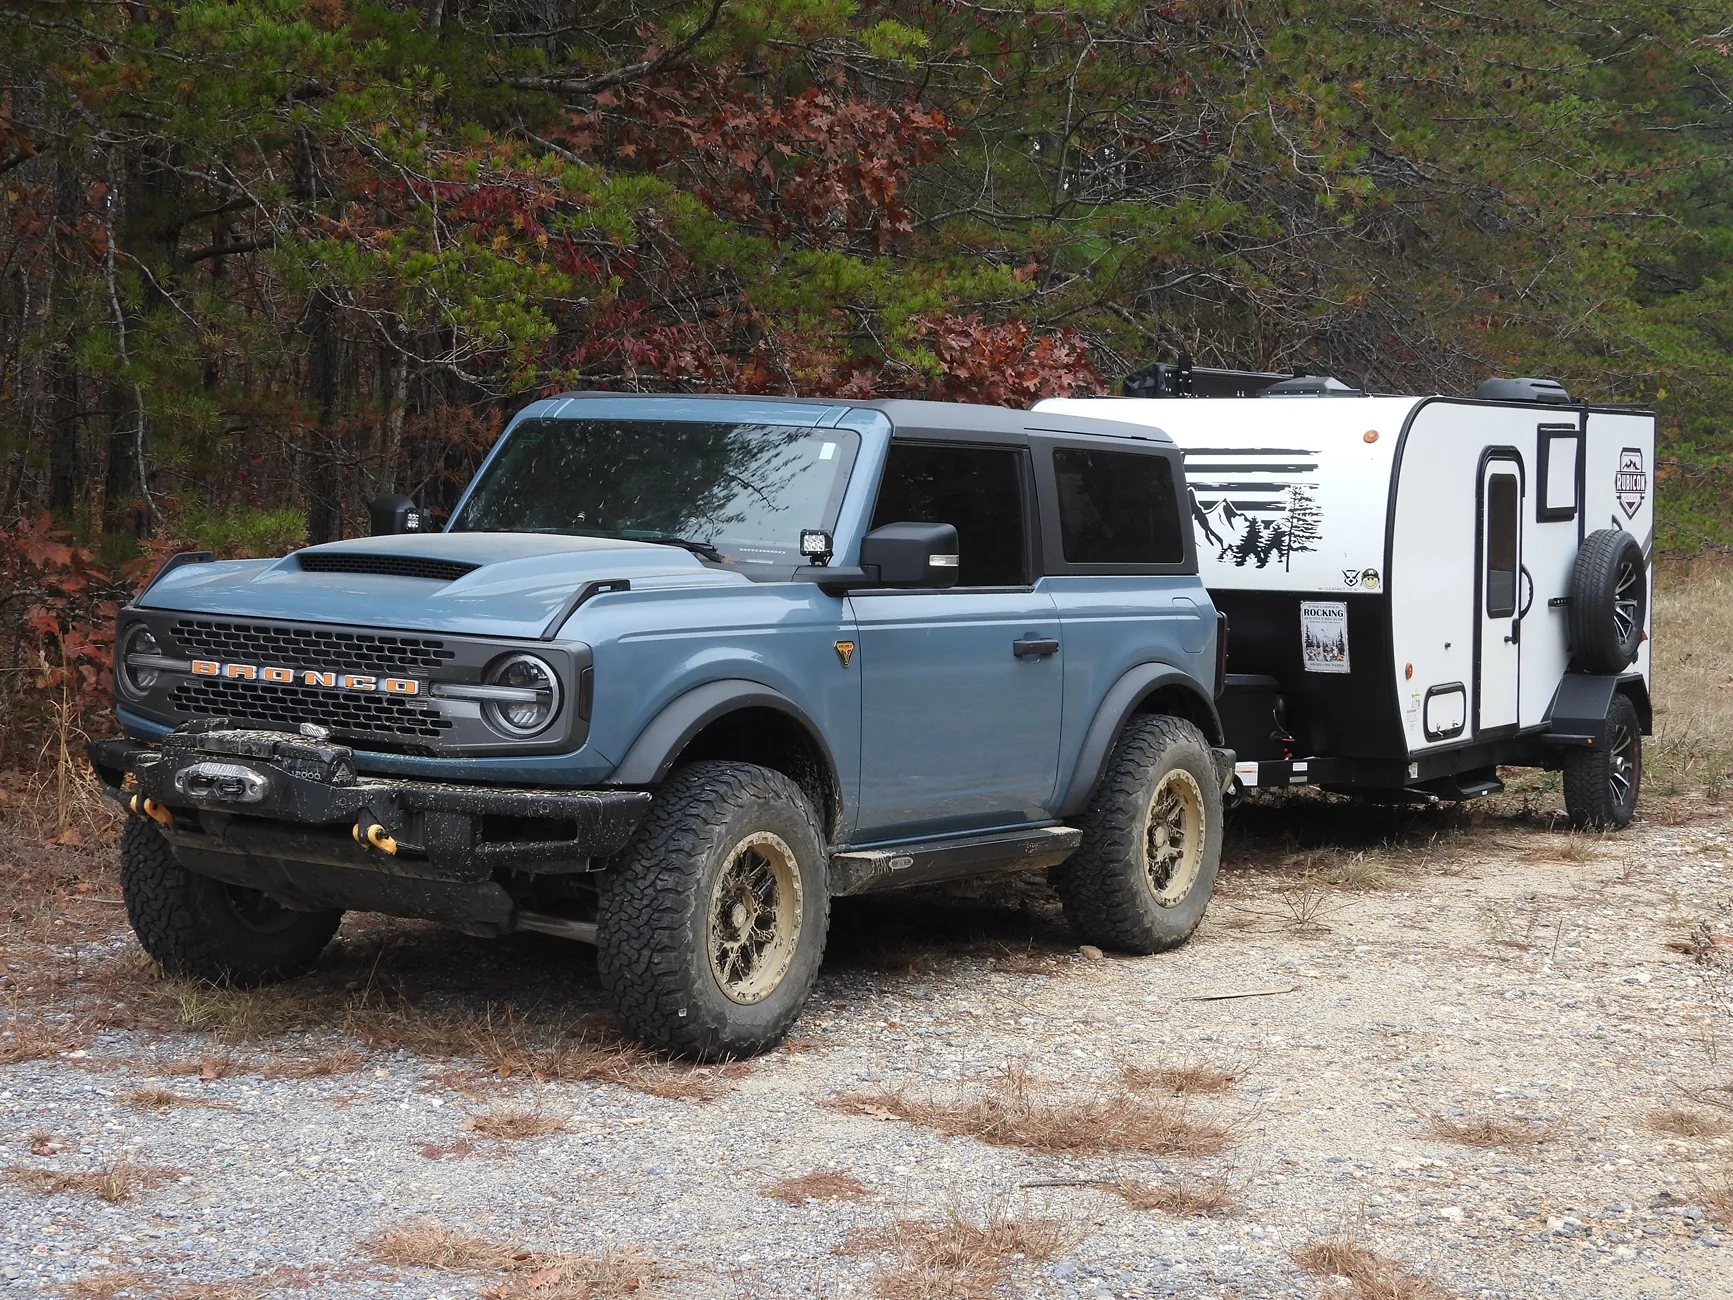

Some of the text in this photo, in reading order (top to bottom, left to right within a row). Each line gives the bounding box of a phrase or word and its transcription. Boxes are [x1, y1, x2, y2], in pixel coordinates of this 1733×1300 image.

[1616, 474, 1645, 491] RUBICON
[1303, 608, 1344, 617] ROCKING
[191, 660, 419, 695] BRONCO
[291, 770, 321, 780] 12000
